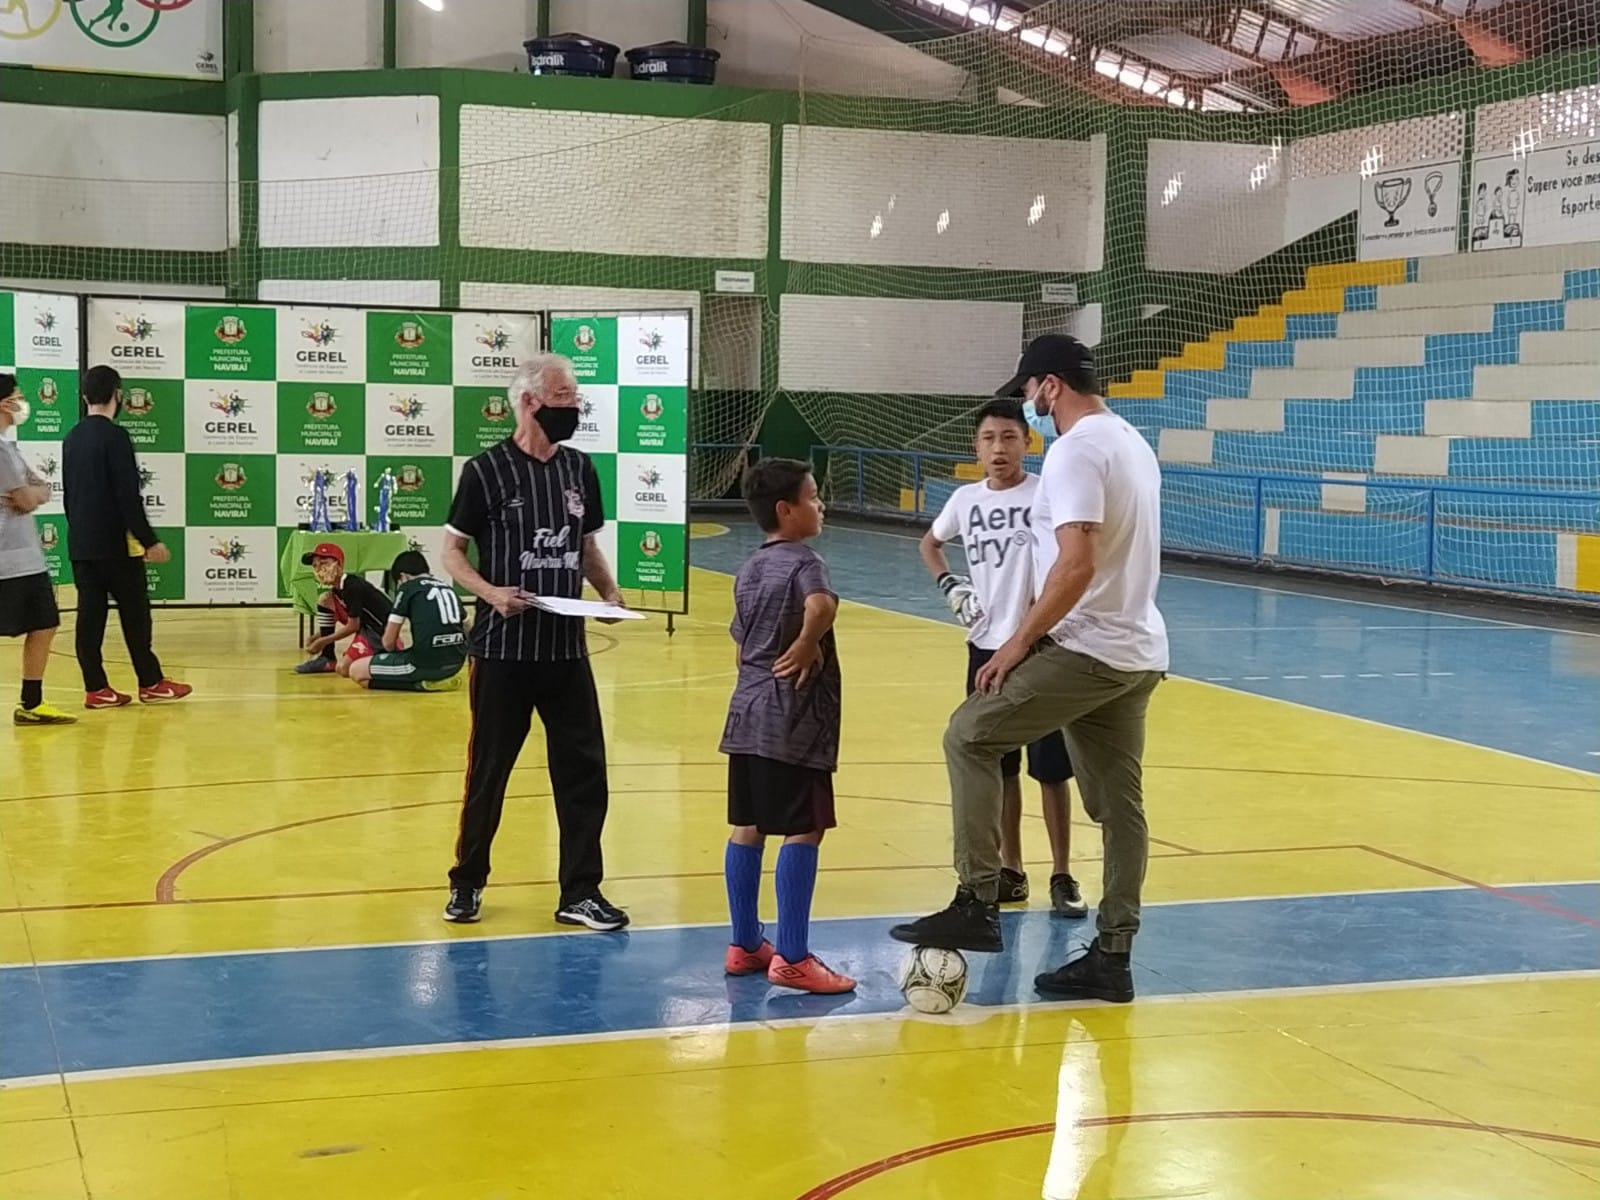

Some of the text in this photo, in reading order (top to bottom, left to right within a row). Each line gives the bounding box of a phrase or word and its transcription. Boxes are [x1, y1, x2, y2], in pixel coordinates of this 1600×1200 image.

[1527, 175, 1558, 196] Supere
[32, 336, 62, 347] GEREL
[111, 346, 165, 358] GEREL
[296, 351, 347, 363] GEREL
[471, 356, 520, 368] GEREL
[636, 355, 669, 366] GEREL
[214, 363, 248, 371] NAVIRAÍ
[393, 368, 426, 376] NAVIRAÍ
[205, 422, 257, 433] GEREL
[385, 425, 435, 437] GEREL
[575, 422, 600, 432] EREL
[131, 434, 156, 443] VIRAÍ
[305, 437, 338, 446] NAVIRAÍ
[635, 492, 667, 502] GEREL
[214, 510, 248, 518] NAVIRAÍ
[533, 525, 571, 549] Fiel
[205, 568, 257, 579] GEREL
[426, 587, 461, 624] 10
